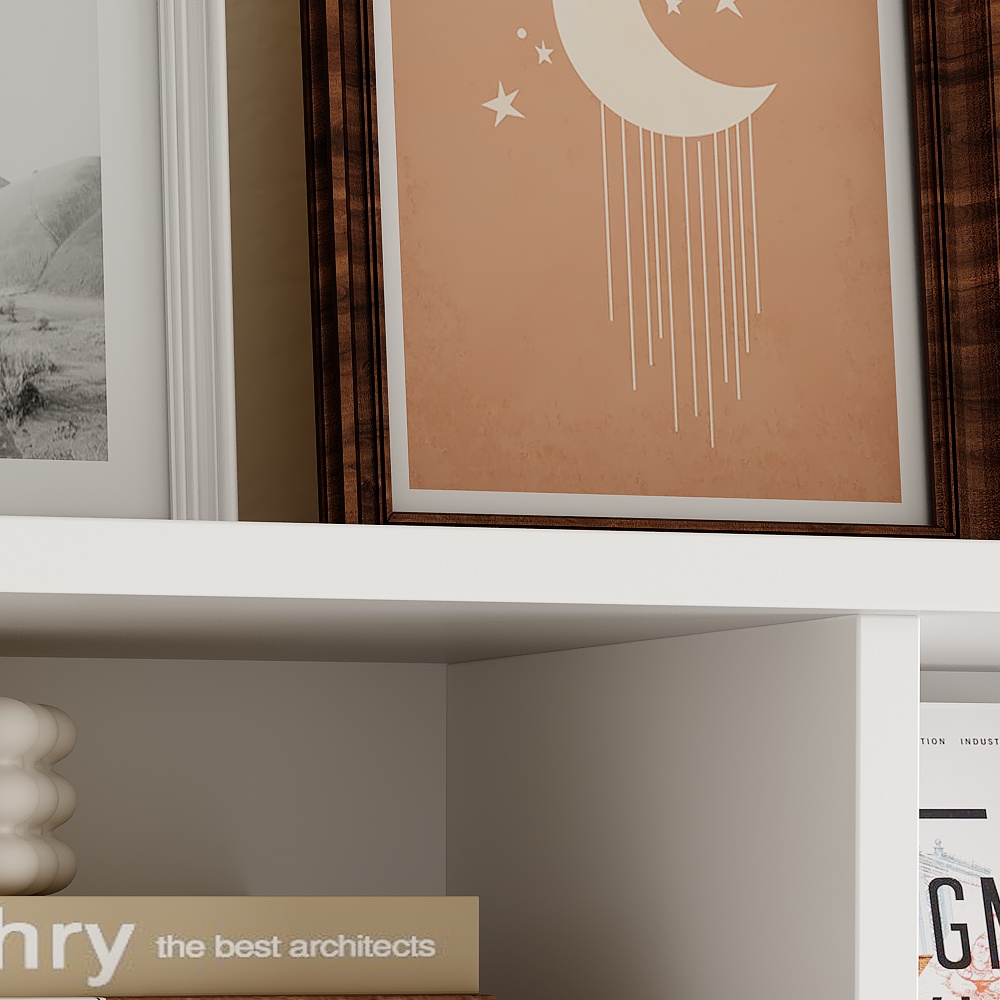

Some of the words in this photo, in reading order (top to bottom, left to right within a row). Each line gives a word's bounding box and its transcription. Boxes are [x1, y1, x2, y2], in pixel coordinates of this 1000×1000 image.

[920, 737, 945, 745] TION
[960, 737, 999, 745] INDUST
[156, 936, 206, 959] the
[215, 935, 282, 959] best
[290, 934, 437, 958] architects
